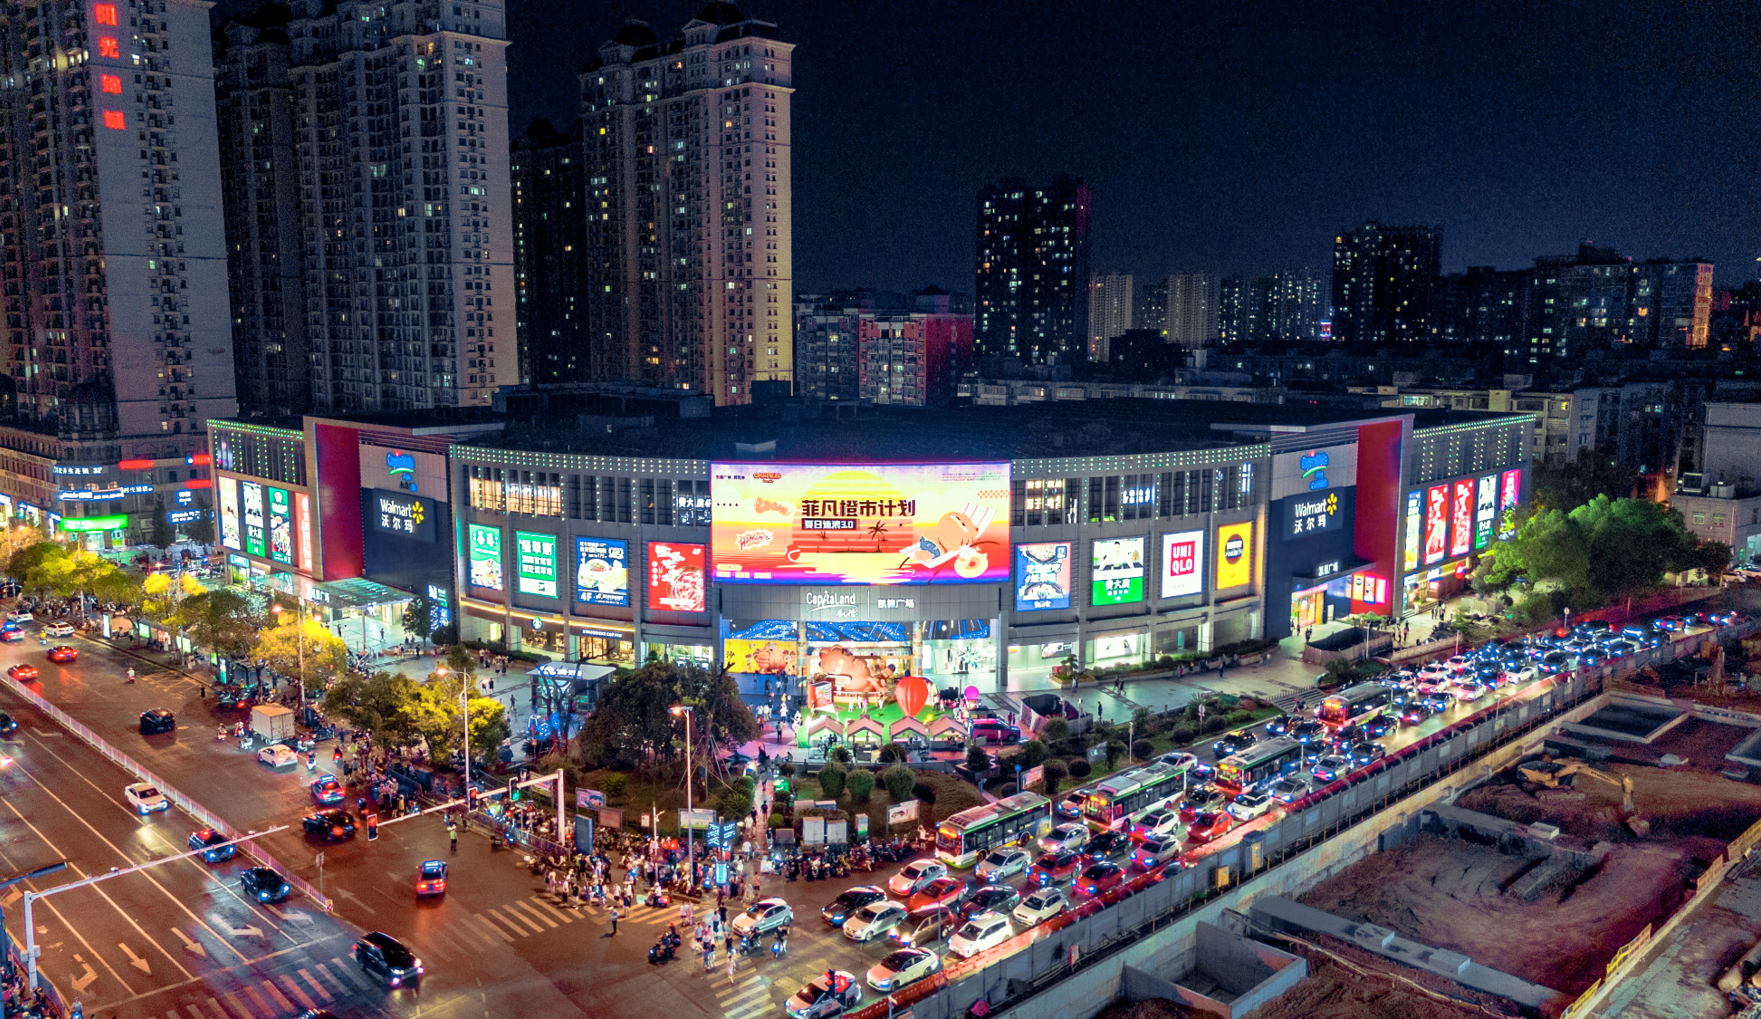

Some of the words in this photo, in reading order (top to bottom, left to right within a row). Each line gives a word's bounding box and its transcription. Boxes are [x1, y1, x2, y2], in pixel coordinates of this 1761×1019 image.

[380, 498, 412, 518] Walmart
[802, 500, 916, 516] 菲凡橙市计划
[1295, 499, 1327, 518] Walmart
[381, 514, 413, 533] 沃尔玛
[1294, 514, 1326, 534] 沃尔玛
[1173, 544, 1192, 558] UNI
[1172, 558, 1192, 574] QLO
[580, 592, 592, 601] 4F
[806, 590, 856, 606] CapitaLand
[878, 598, 914, 608] 凯德广场
